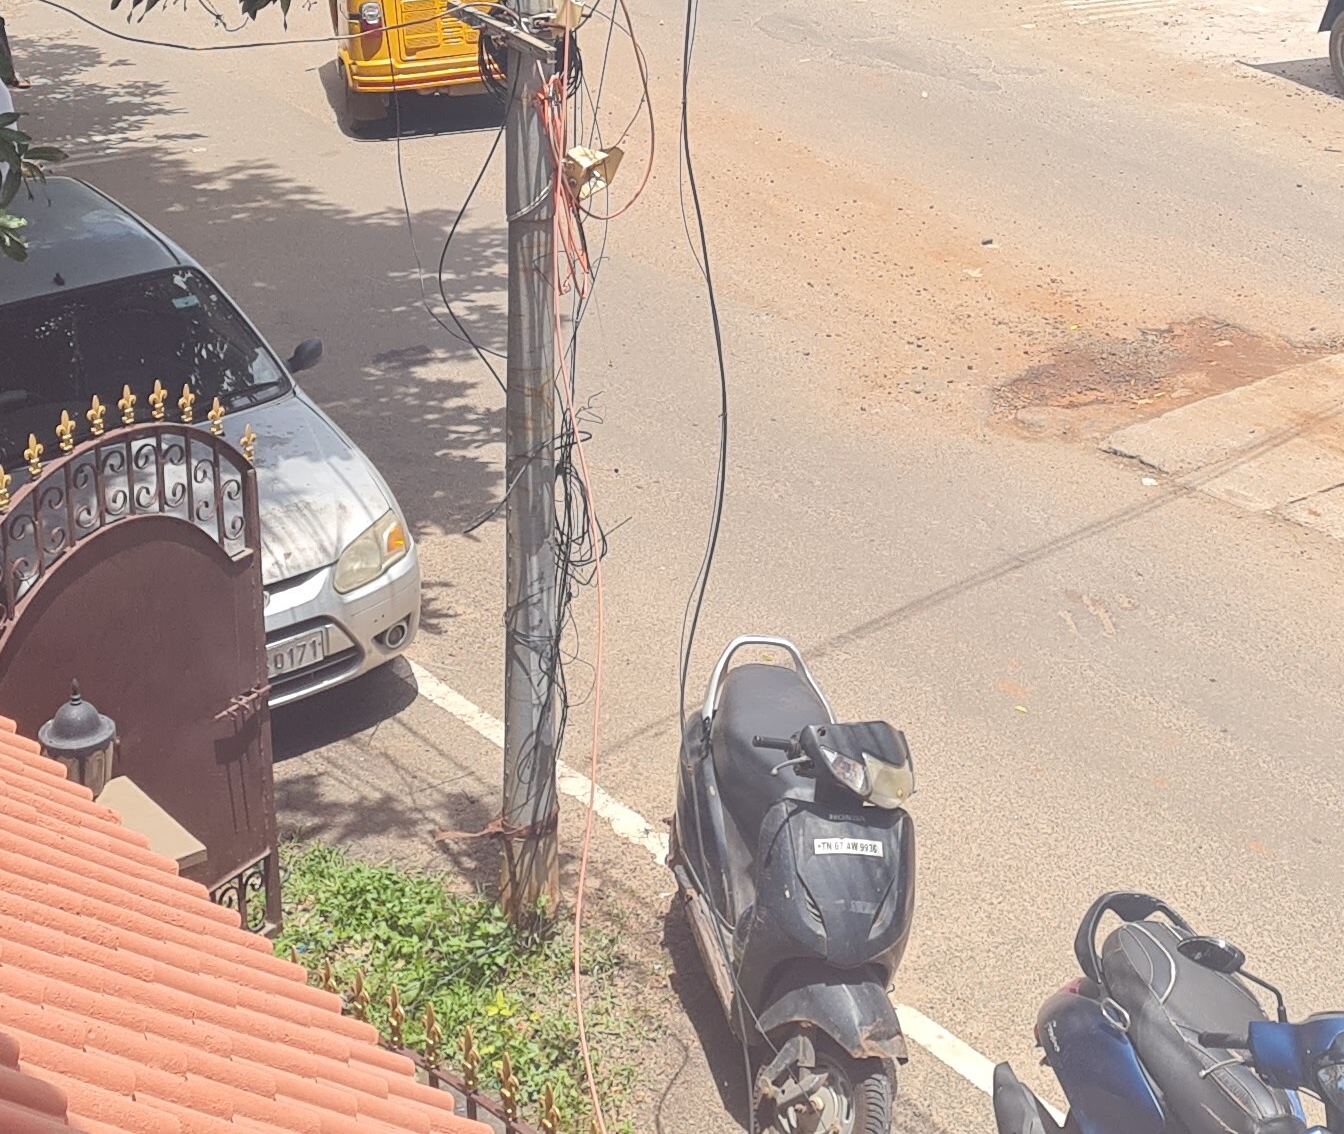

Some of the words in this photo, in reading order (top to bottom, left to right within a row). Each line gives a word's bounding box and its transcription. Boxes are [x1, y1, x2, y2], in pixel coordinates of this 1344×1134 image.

[829, 814, 865, 822] HONDA
[821, 841, 832, 851] TN
[846, 842, 858, 851] AW
